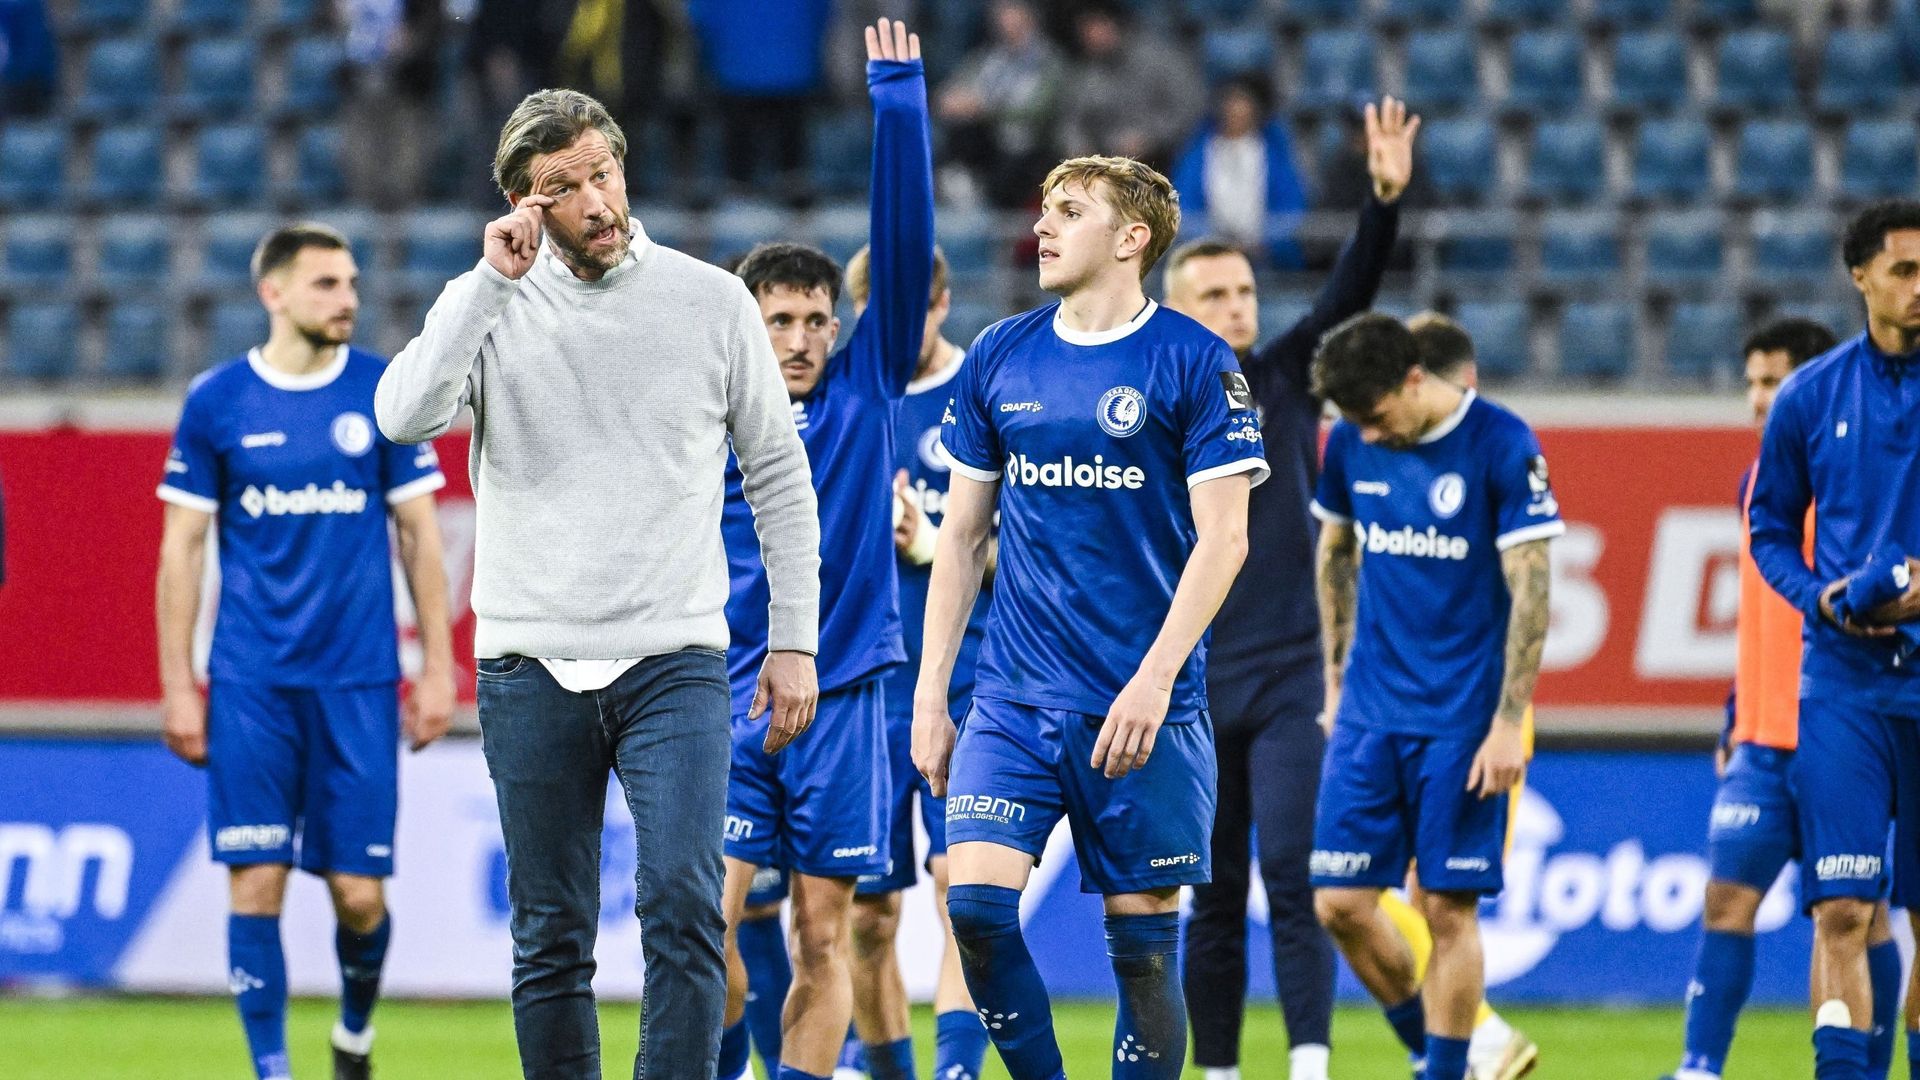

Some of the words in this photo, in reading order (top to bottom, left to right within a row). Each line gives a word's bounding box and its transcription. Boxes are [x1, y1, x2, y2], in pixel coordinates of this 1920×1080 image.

[1000, 402, 1033, 413] CRAFT
[1019, 454, 1146, 490] baloise
[1367, 521, 1470, 561] baloise
[971, 812, 1009, 824] LOGISTICS
[1150, 855, 1188, 867] CRAFT
